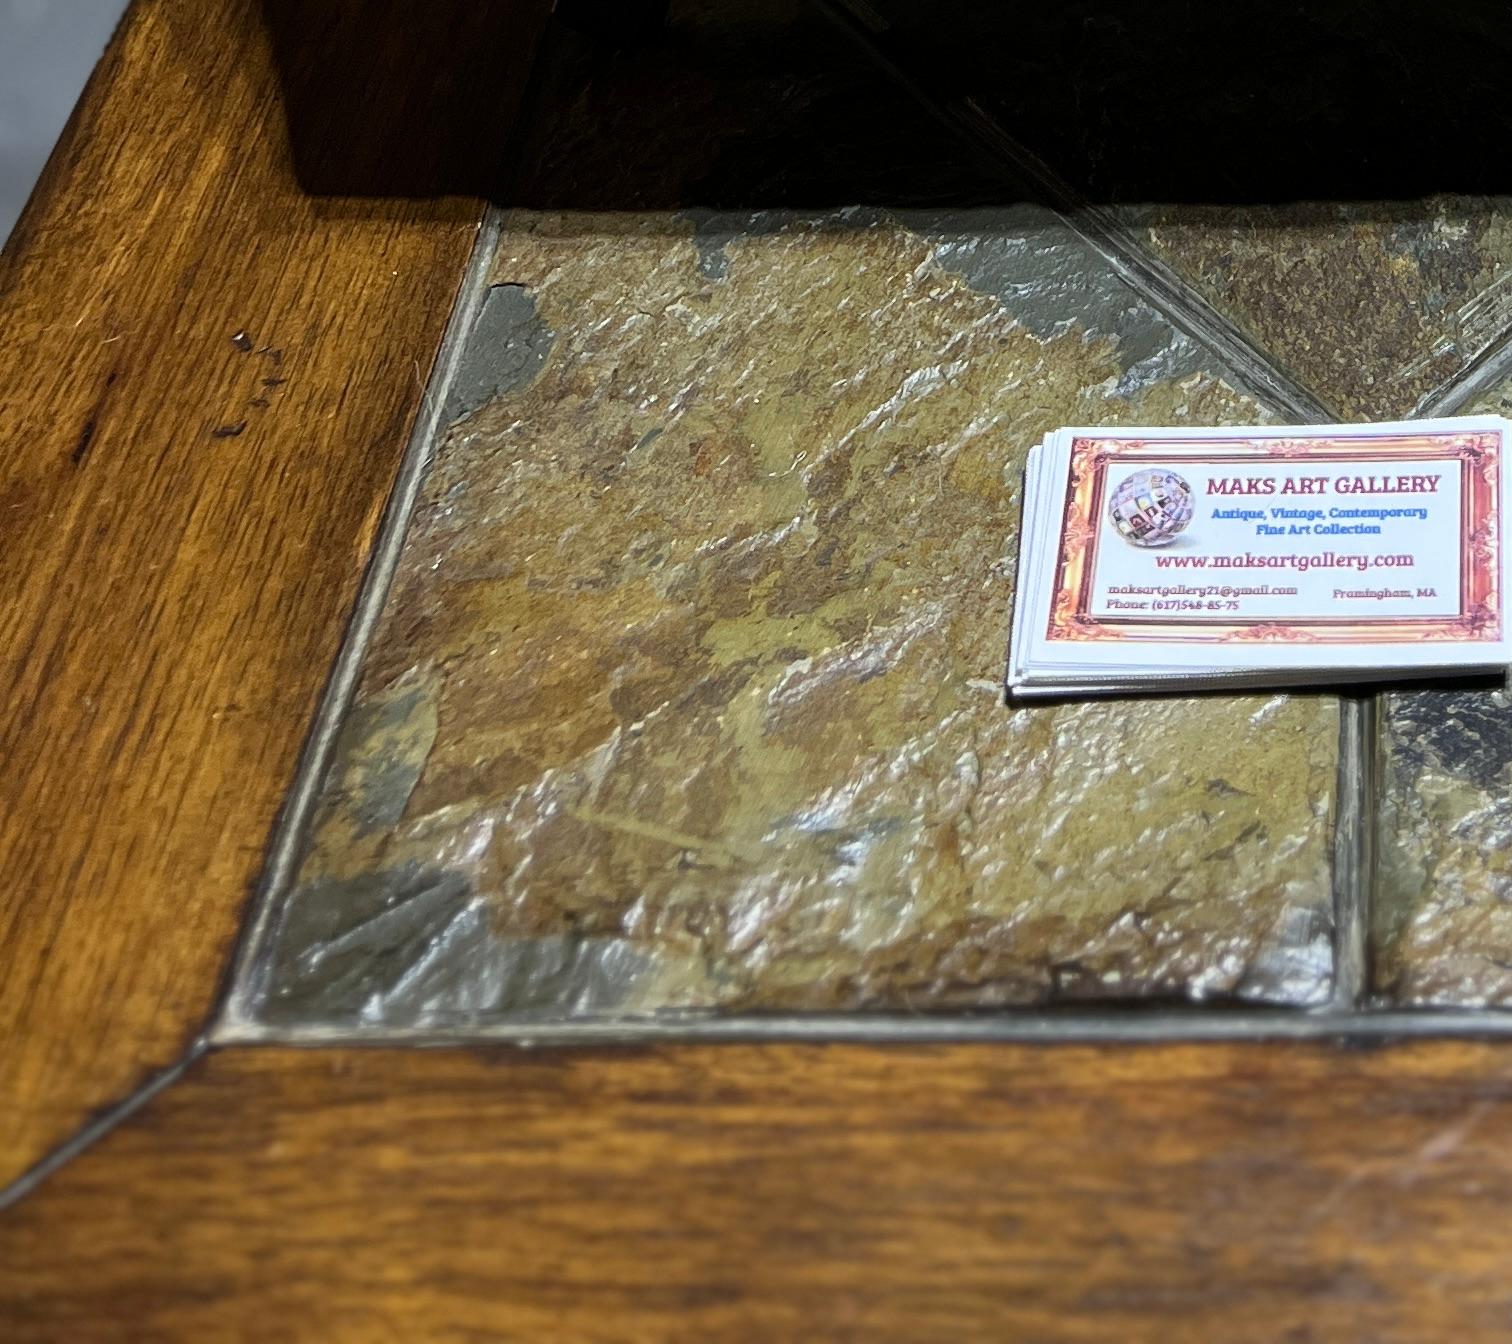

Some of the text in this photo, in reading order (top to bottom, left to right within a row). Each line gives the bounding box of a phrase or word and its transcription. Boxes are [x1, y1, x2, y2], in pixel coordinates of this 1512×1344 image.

[1206, 475, 1441, 495] MAKS ART GALLERY
[1211, 507, 1428, 521] Antique, Vintage, Contemporary
[1256, 524, 1381, 535] Fine Art Collection
[1156, 552, 1414, 571] www.maksartgallery.com
[1108, 584, 1298, 597] maksartgallery21@gmail.com
[1333, 588, 1438, 600] Framingham, MA
[1106, 599, 1147, 610] Phone:
